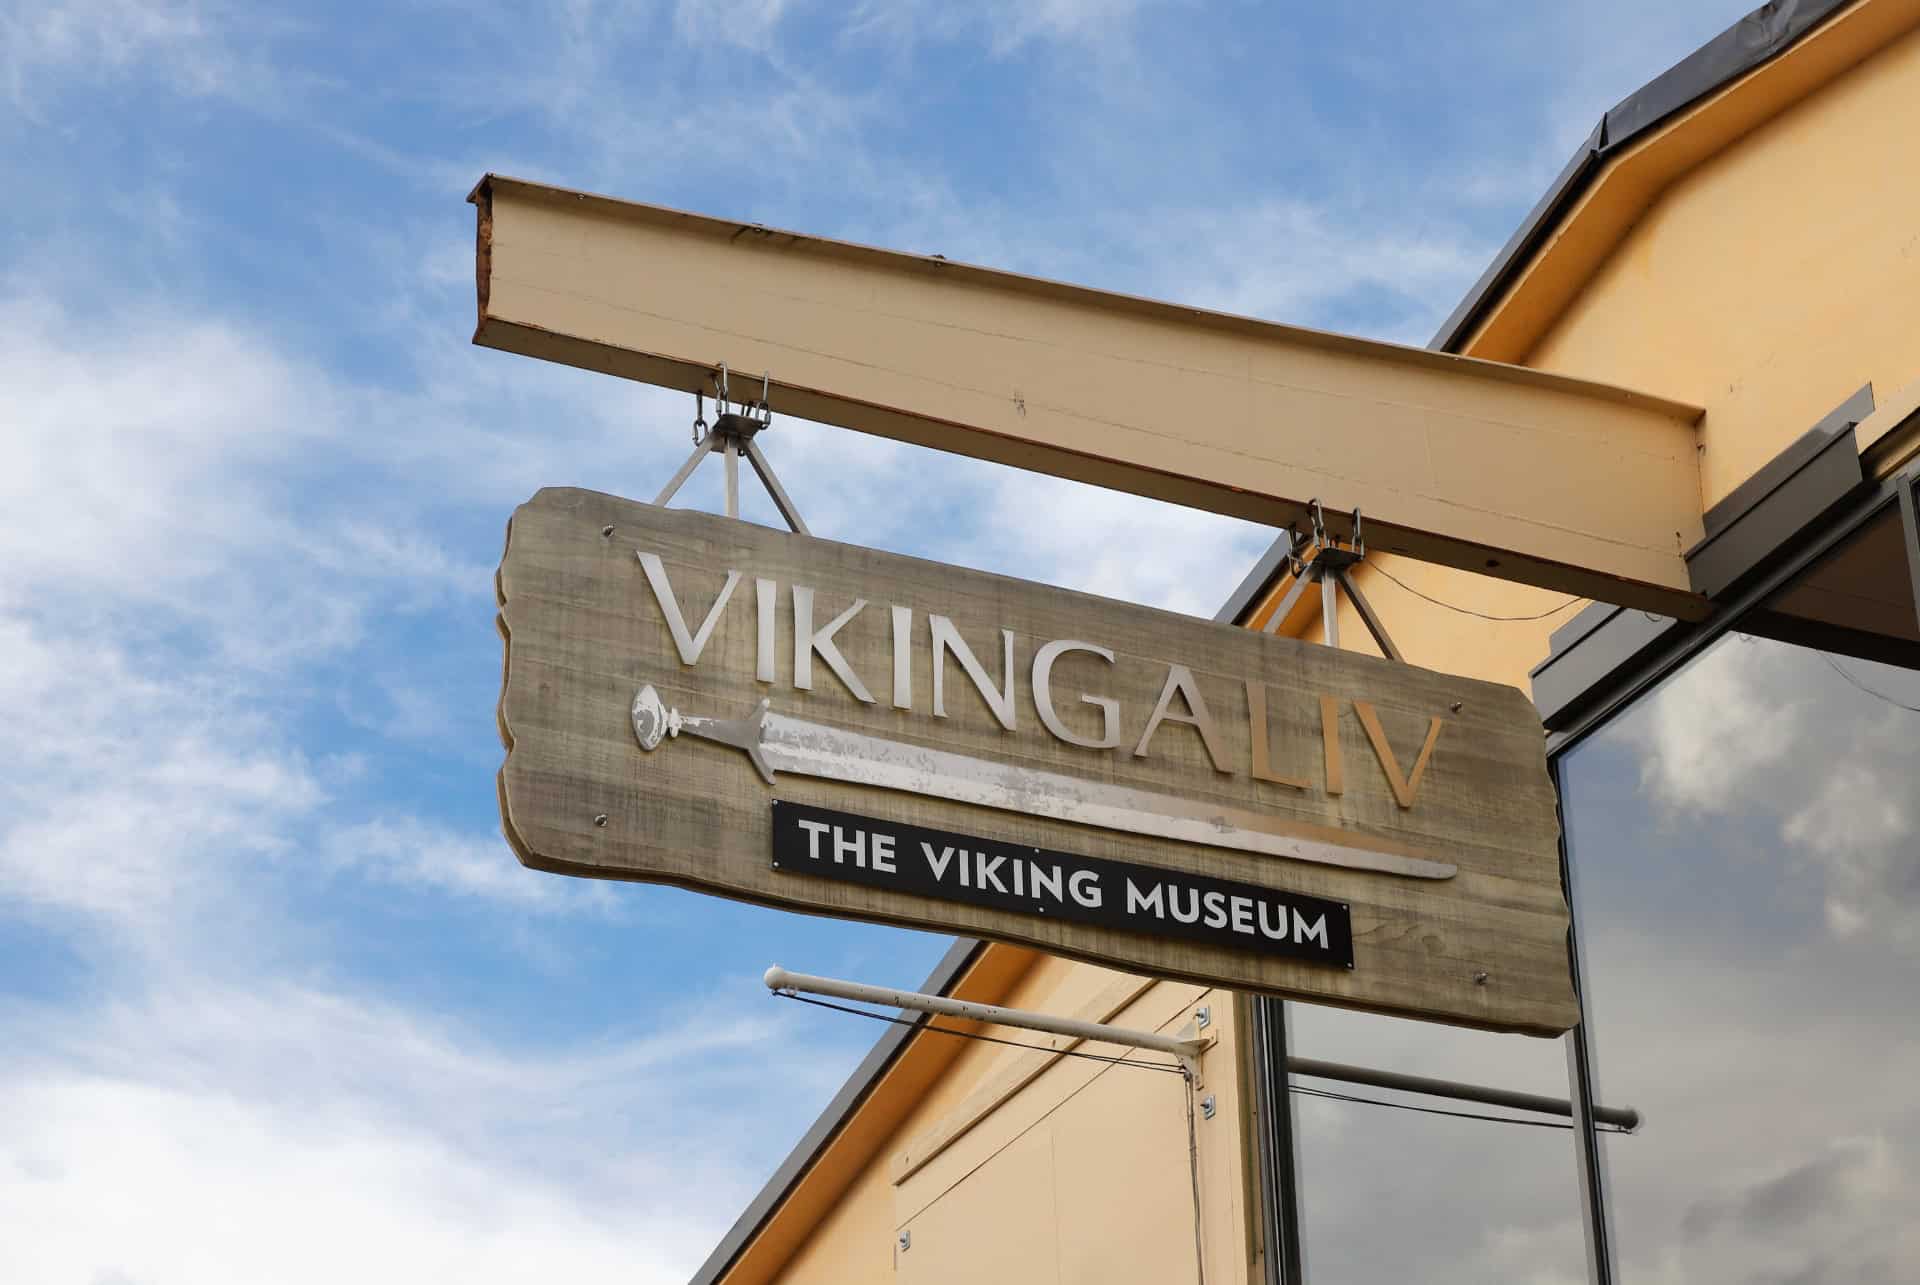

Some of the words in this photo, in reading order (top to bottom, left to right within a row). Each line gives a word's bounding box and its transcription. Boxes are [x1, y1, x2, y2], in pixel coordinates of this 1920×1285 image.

[635, 550, 1445, 809] VIKINGALIV
[798, 819, 897, 874] THE
[919, 841, 1103, 908] VIKING
[1126, 876, 1330, 949] MUSEUM
